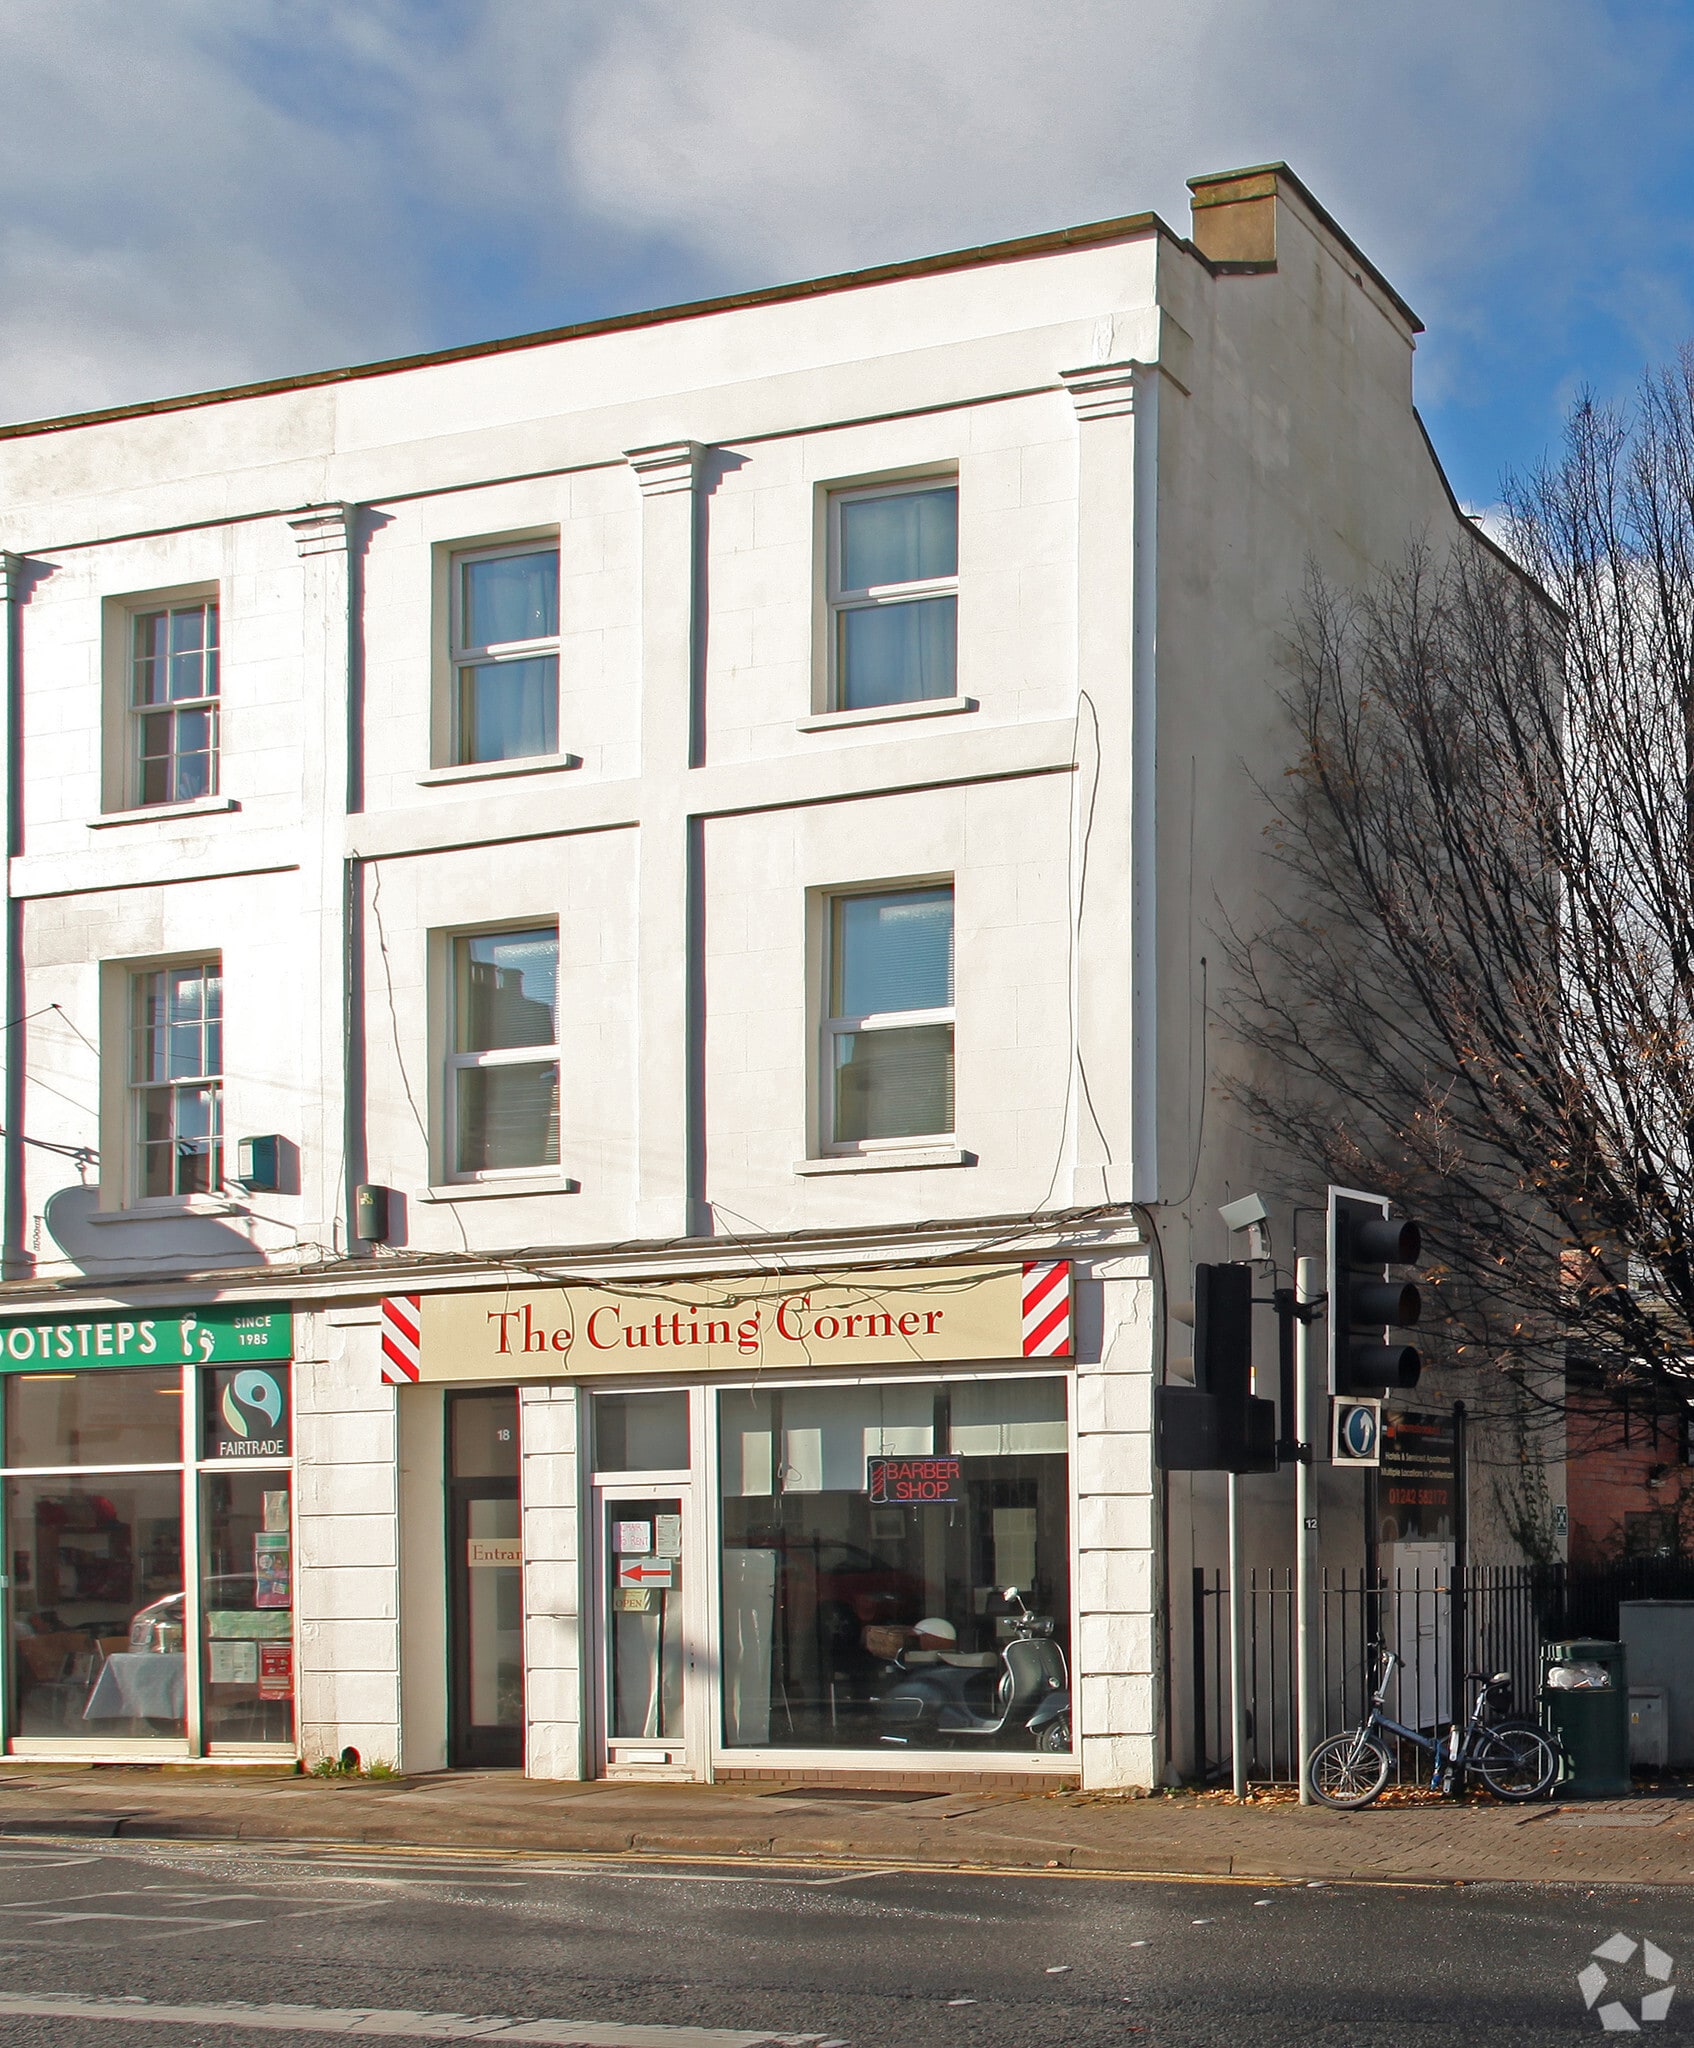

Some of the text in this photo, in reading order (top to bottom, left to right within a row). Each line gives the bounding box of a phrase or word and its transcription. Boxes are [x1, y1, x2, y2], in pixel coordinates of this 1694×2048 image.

[234, 1315, 272, 1329] SINCE
[486, 1296, 944, 1356] The Cutting Corner
[0, 1321, 157, 1360] OTSTEPS
[239, 1333, 268, 1346] 1985
[497, 1429, 510, 1441] 18
[219, 1440, 284, 1456] FAIRTRADE
[886, 1462, 960, 1479] BARBER
[895, 1481, 949, 1499] SHOP
[1389, 1488, 1417, 1504] 01242
[1305, 1519, 1318, 1529] 12
[630, 1535, 649, 1546] RENT
[615, 1599, 642, 1608] OPEN
